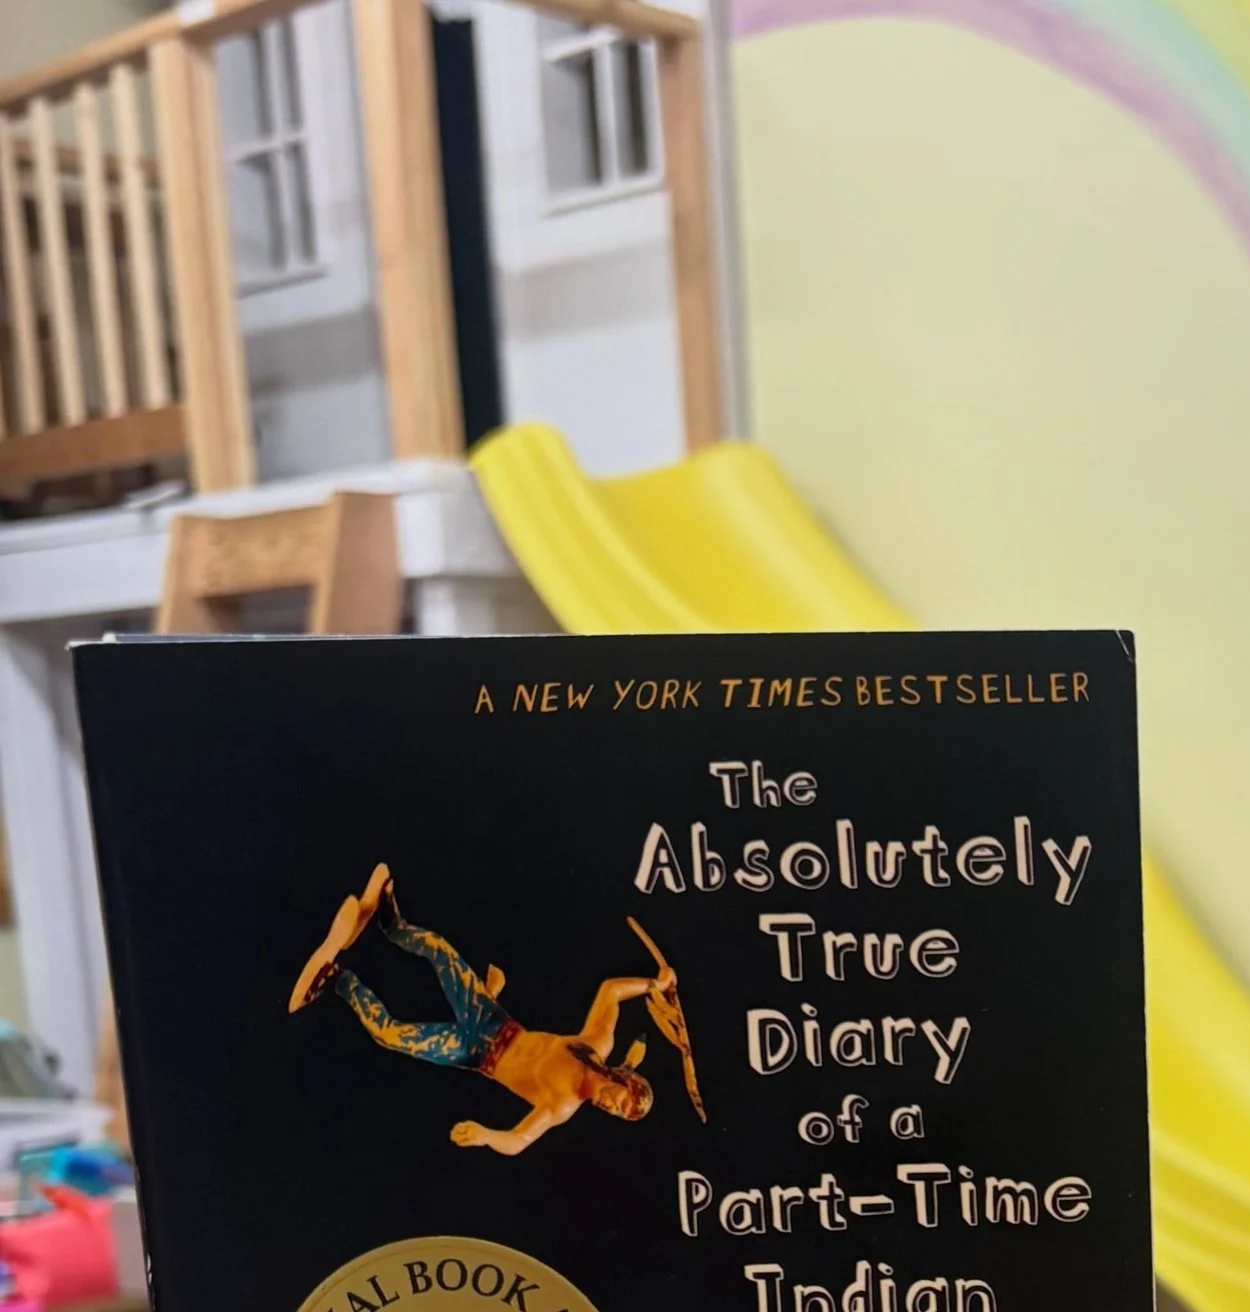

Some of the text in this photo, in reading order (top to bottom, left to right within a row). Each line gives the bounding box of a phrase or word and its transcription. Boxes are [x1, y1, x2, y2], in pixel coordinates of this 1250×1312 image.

[474, 672, 1090, 714] A NEW YORK TIMES BESTSELLER
[708, 759, 818, 809] The
[633, 815, 1093, 905] Absolutely
[758, 913, 960, 982] True
[745, 1002, 971, 1085] Diary
[798, 1094, 925, 1146] of a
[677, 1162, 1093, 1237] Part-Time
